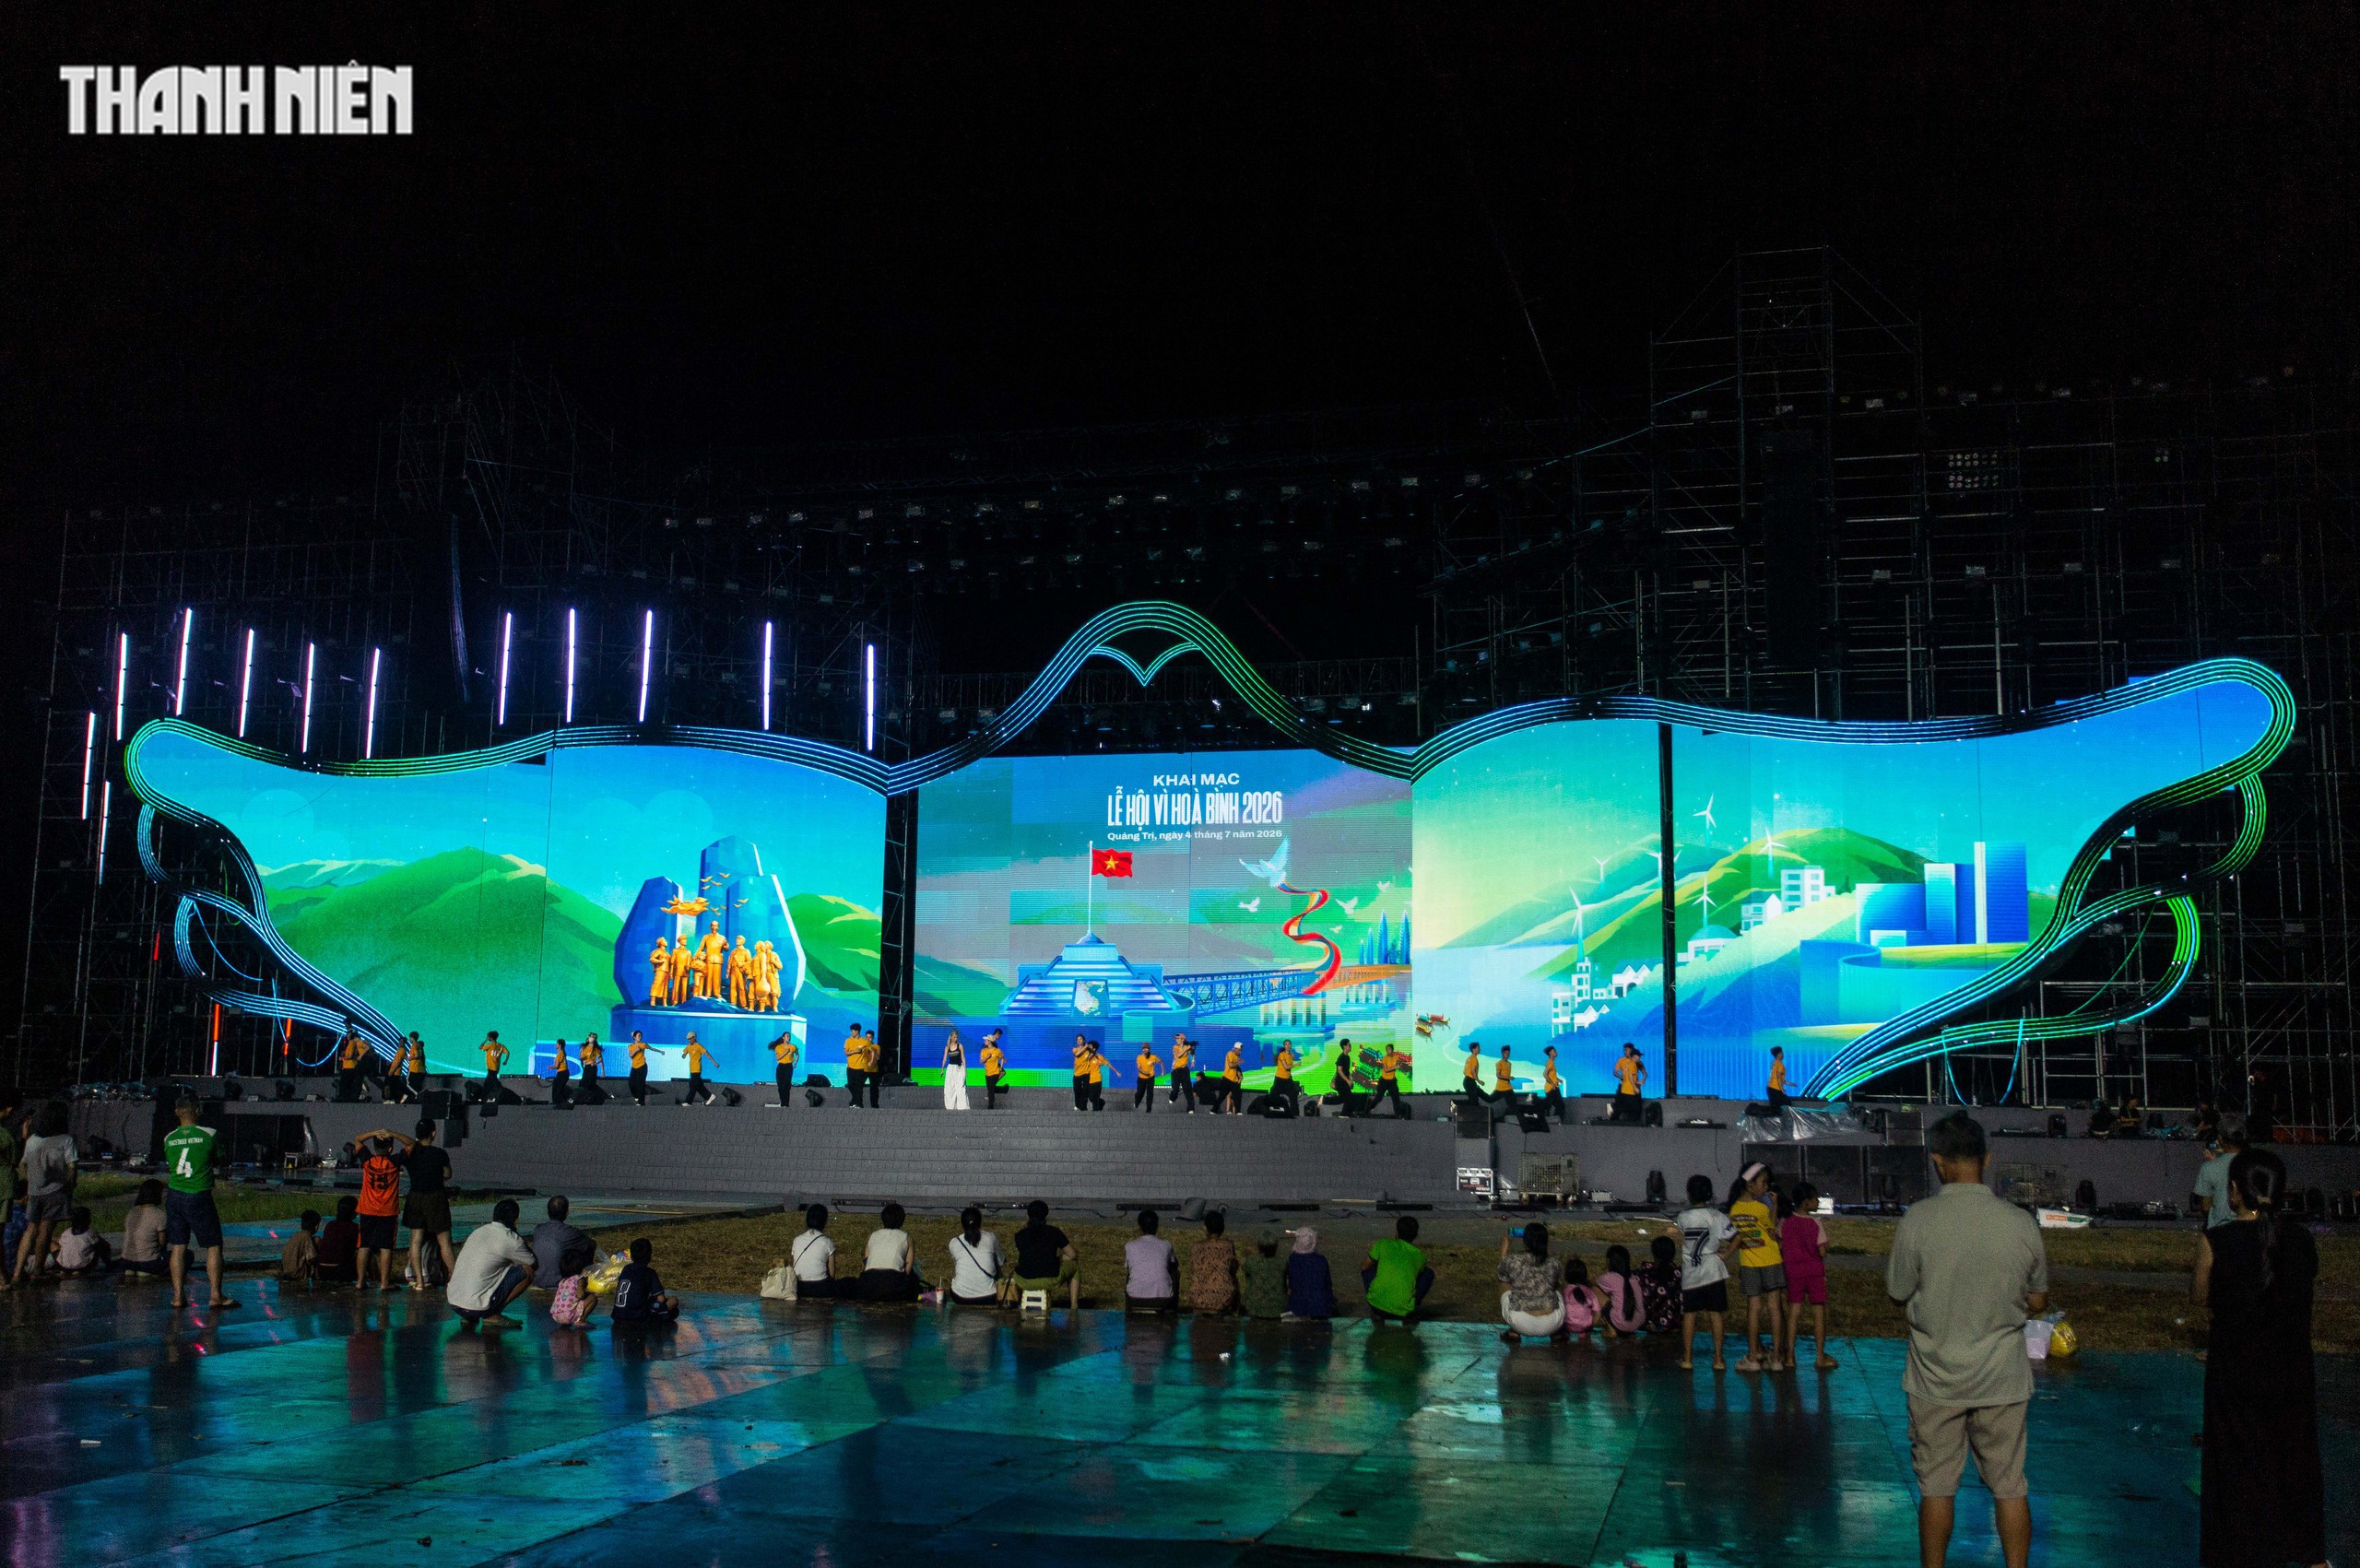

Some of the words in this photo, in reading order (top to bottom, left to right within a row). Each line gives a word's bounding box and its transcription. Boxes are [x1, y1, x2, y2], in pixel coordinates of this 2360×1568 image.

[1153, 774, 1197, 786] KHAI
[1200, 772, 1240, 788] MẠC
[1107, 785, 1123, 826] LỄ
[1126, 788, 1150, 831] HỘI
[1153, 788, 1168, 825] VÌ
[1171, 787, 1202, 826] HOÀ
[1205, 787, 1239, 824] BÌNH
[1242, 791, 1282, 824] 2026
[1141, 831, 1158, 841] Trị,
[1159, 831, 1184, 841] ngày
[1185, 831, 1192, 839] 4
[1194, 831, 1223, 840] tháng
[1233, 830, 1255, 838] năm
[1257, 830, 1282, 838] 2026
[176, 1147, 194, 1178] 4
[1683, 1227, 1710, 1267] 7
[615, 1279, 631, 1308] 8
